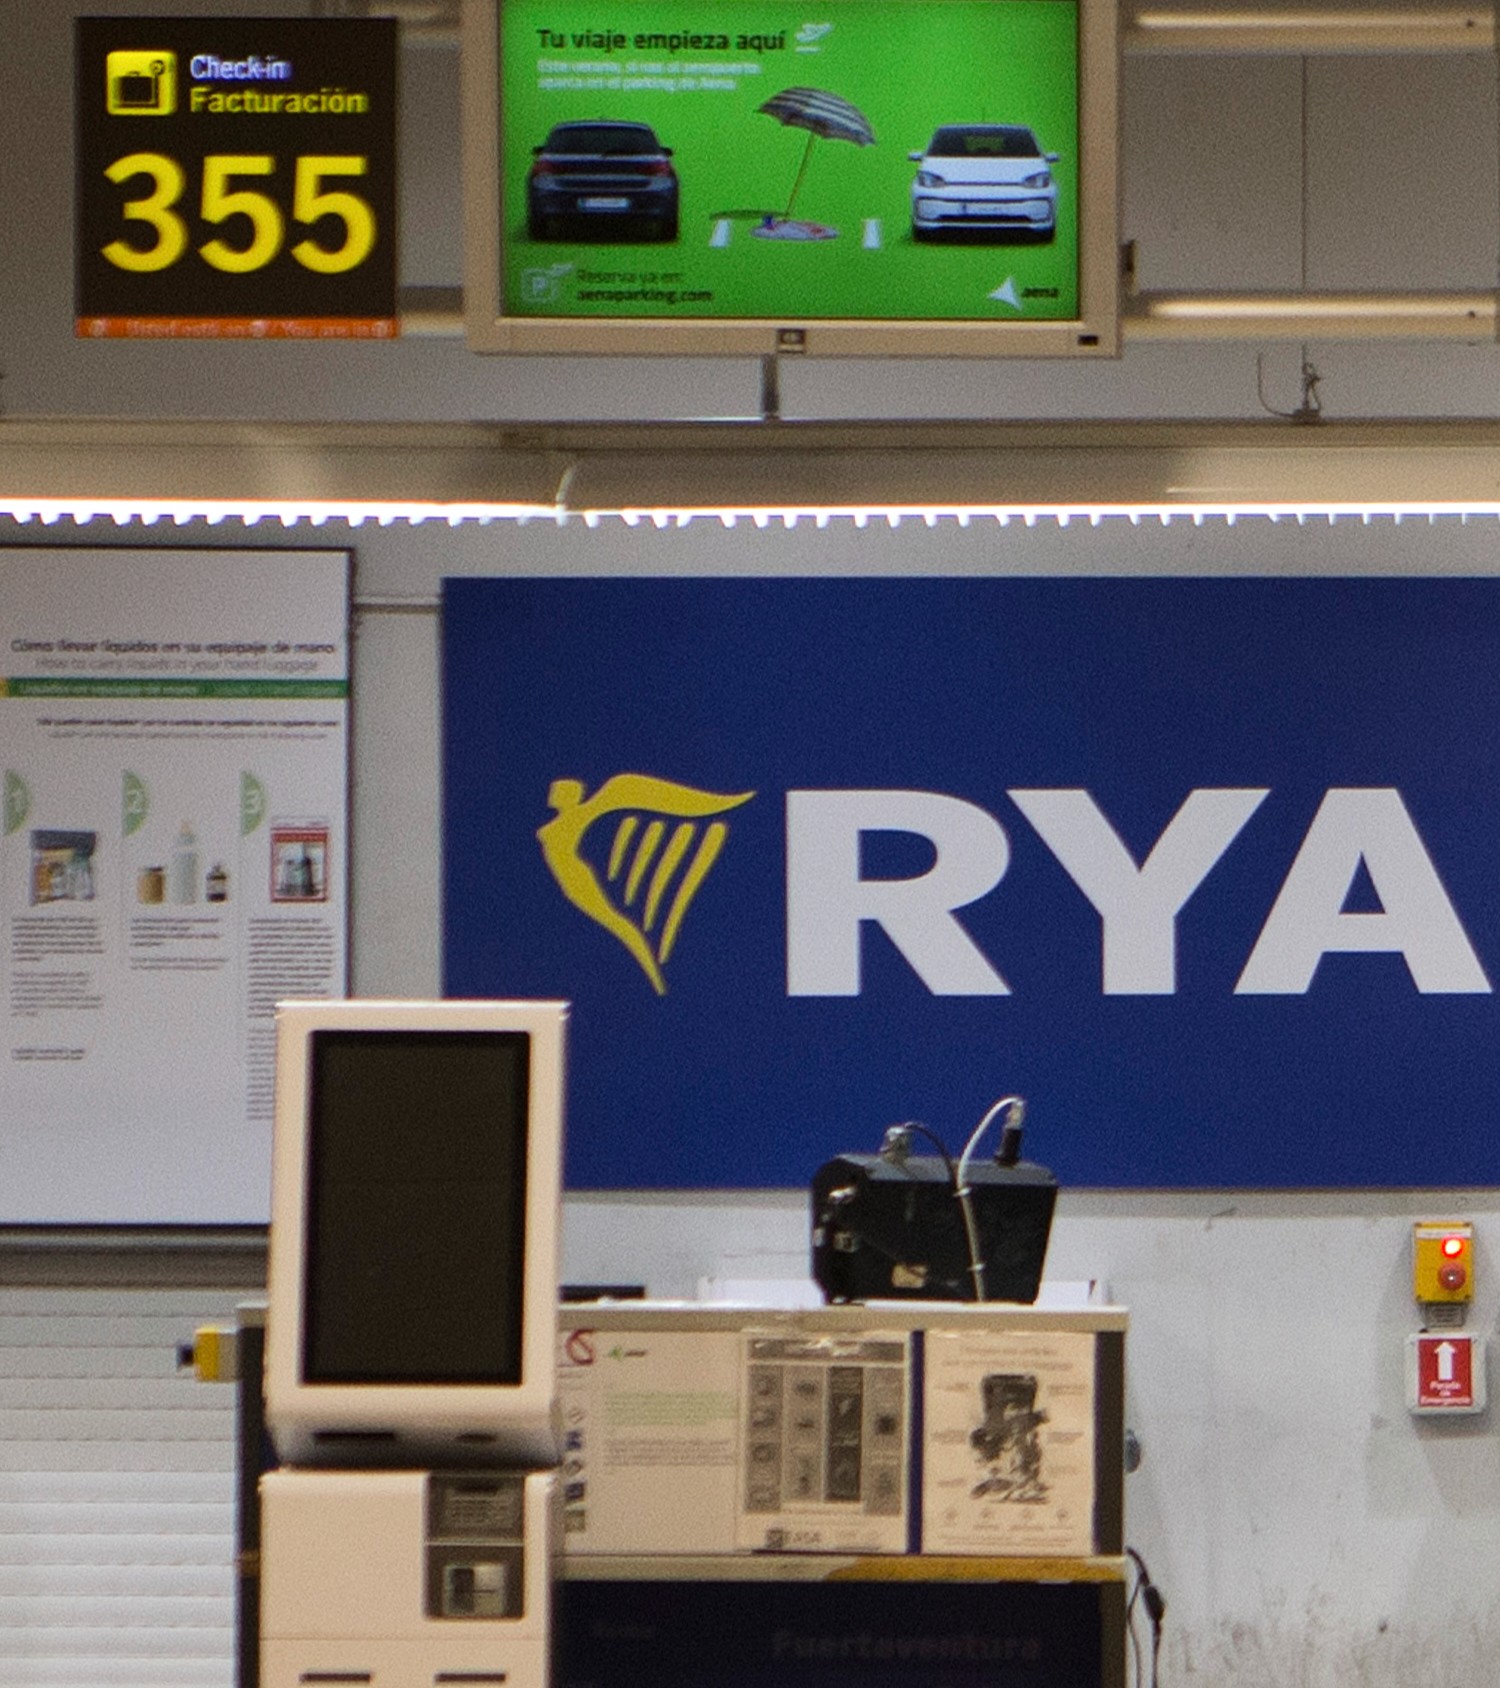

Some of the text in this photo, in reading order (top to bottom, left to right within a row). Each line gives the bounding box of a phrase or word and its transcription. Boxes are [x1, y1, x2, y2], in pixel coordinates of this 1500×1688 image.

[536, 29, 786, 54] Tu viaje empieza aquí
[189, 54, 291, 80] Check-in
[189, 86, 367, 114] Facturación
[101, 152, 376, 274] 355
[577, 289, 712, 305] aenaparking.com
